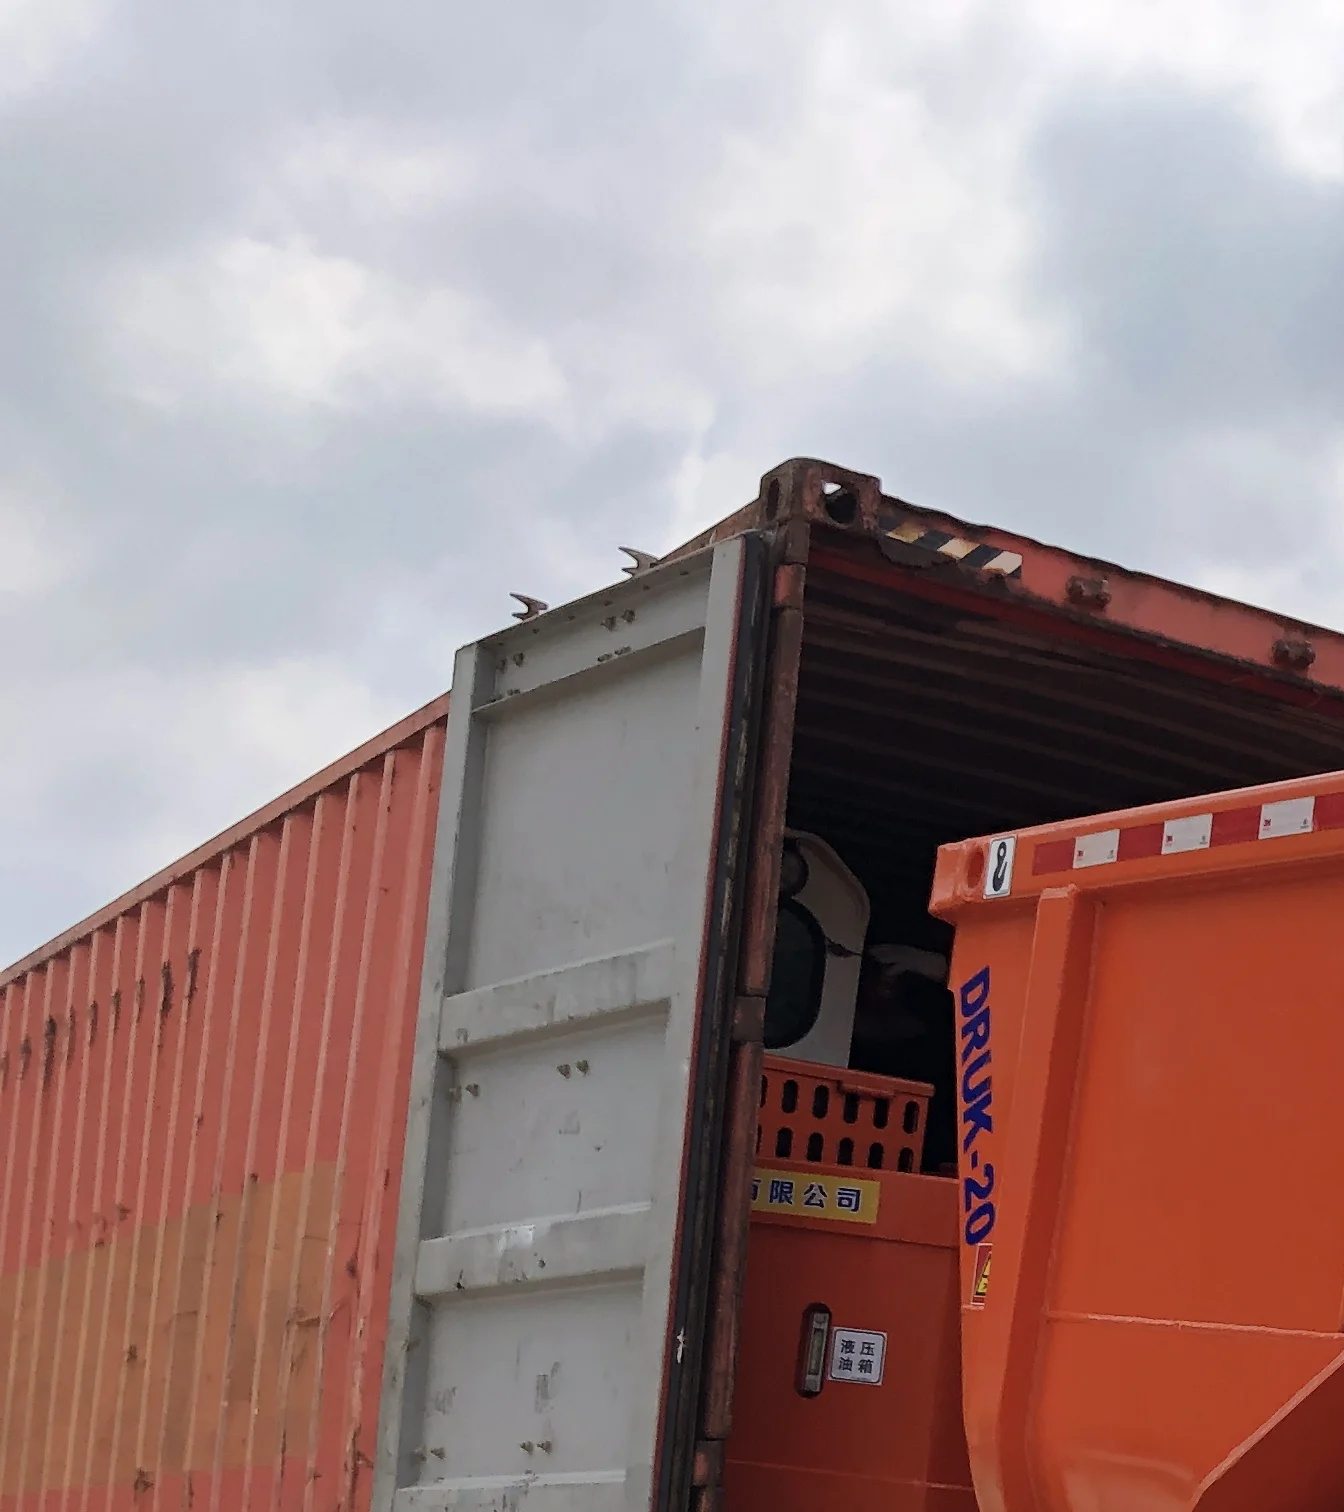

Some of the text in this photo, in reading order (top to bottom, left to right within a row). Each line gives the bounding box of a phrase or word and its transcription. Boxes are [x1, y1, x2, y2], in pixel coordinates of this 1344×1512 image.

[959, 965, 996, 1245] DRUK-20
[840, 1339, 875, 1356] 液压
[838, 1356, 874, 1374] 油箱
